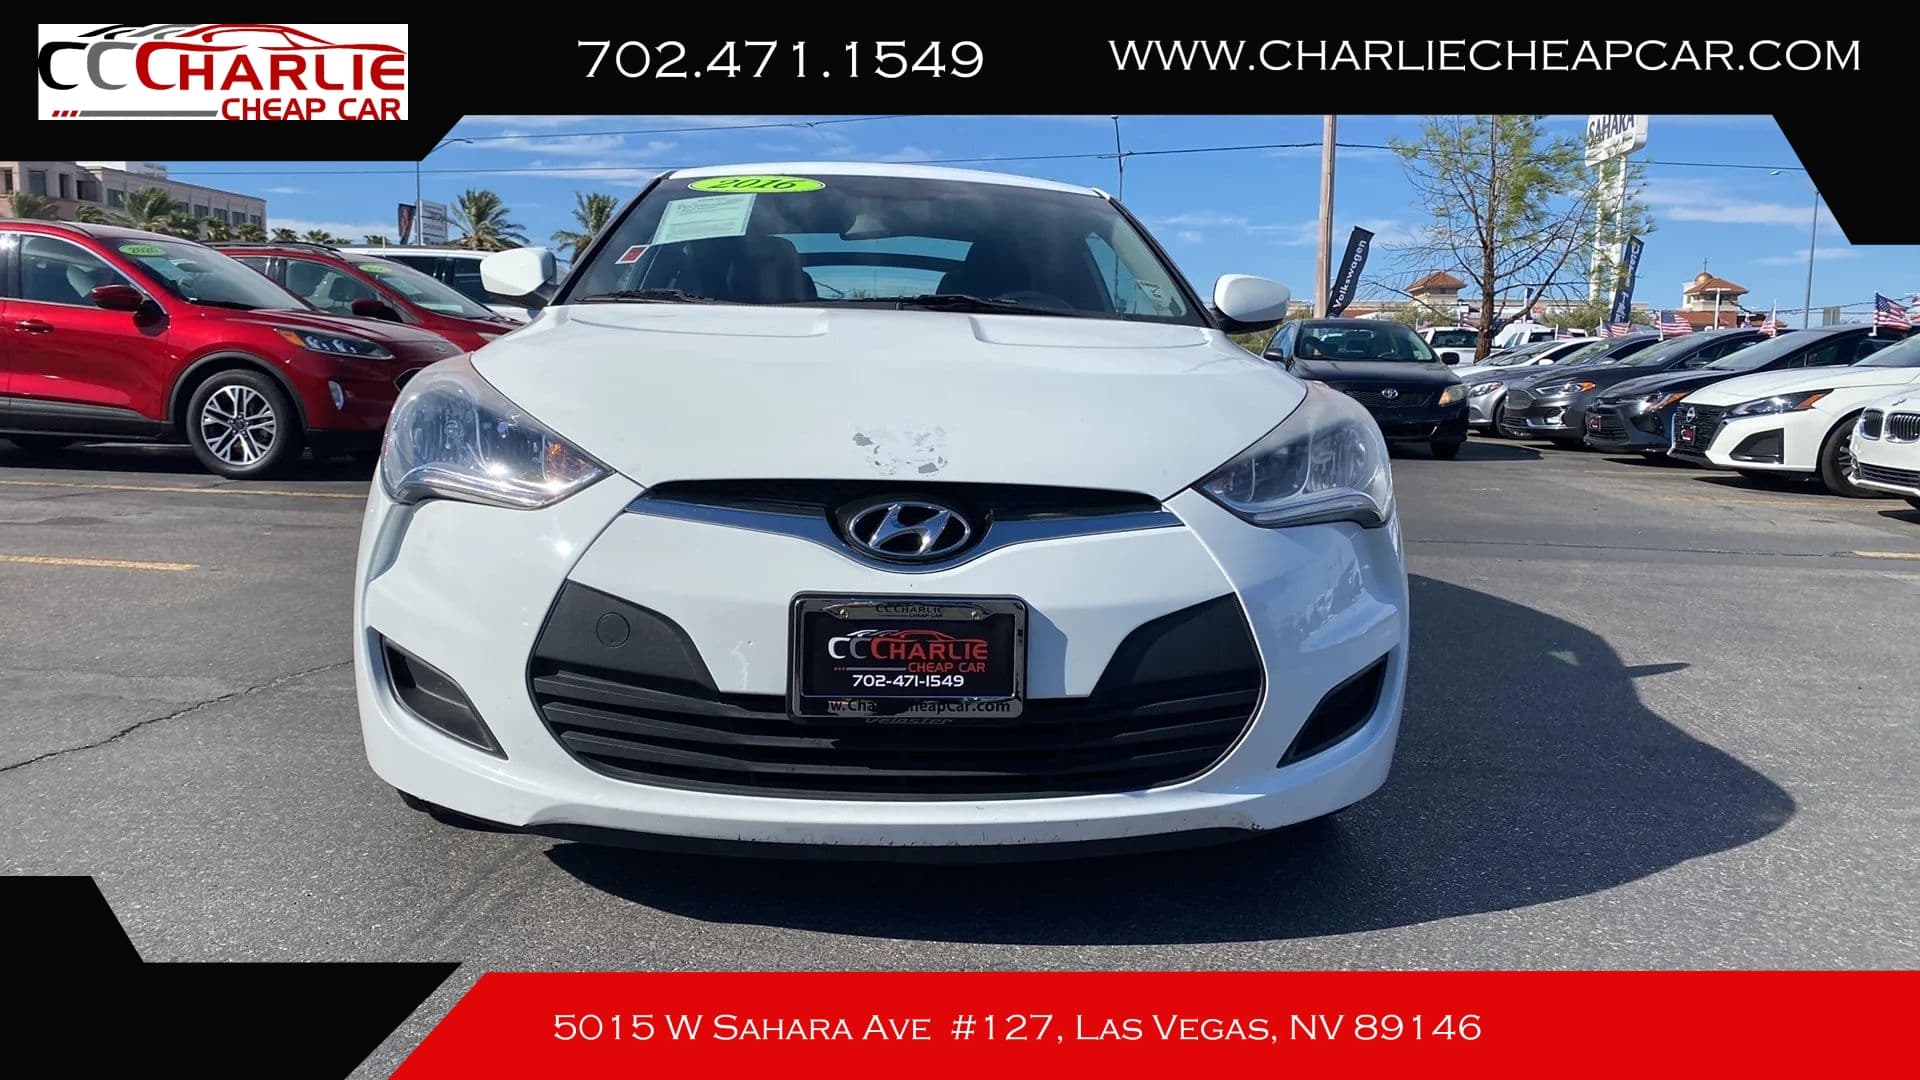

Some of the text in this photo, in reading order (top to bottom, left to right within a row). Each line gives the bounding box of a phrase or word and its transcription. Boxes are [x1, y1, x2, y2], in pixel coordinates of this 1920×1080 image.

[1588, 114, 1635, 145] SAHARA
[708, 178, 797, 190] 2016
[1332, 239, 1368, 308] Volkswagen
[908, 662, 986, 673] CHEAP CAR
[852, 674, 965, 688] 702-471-1549
